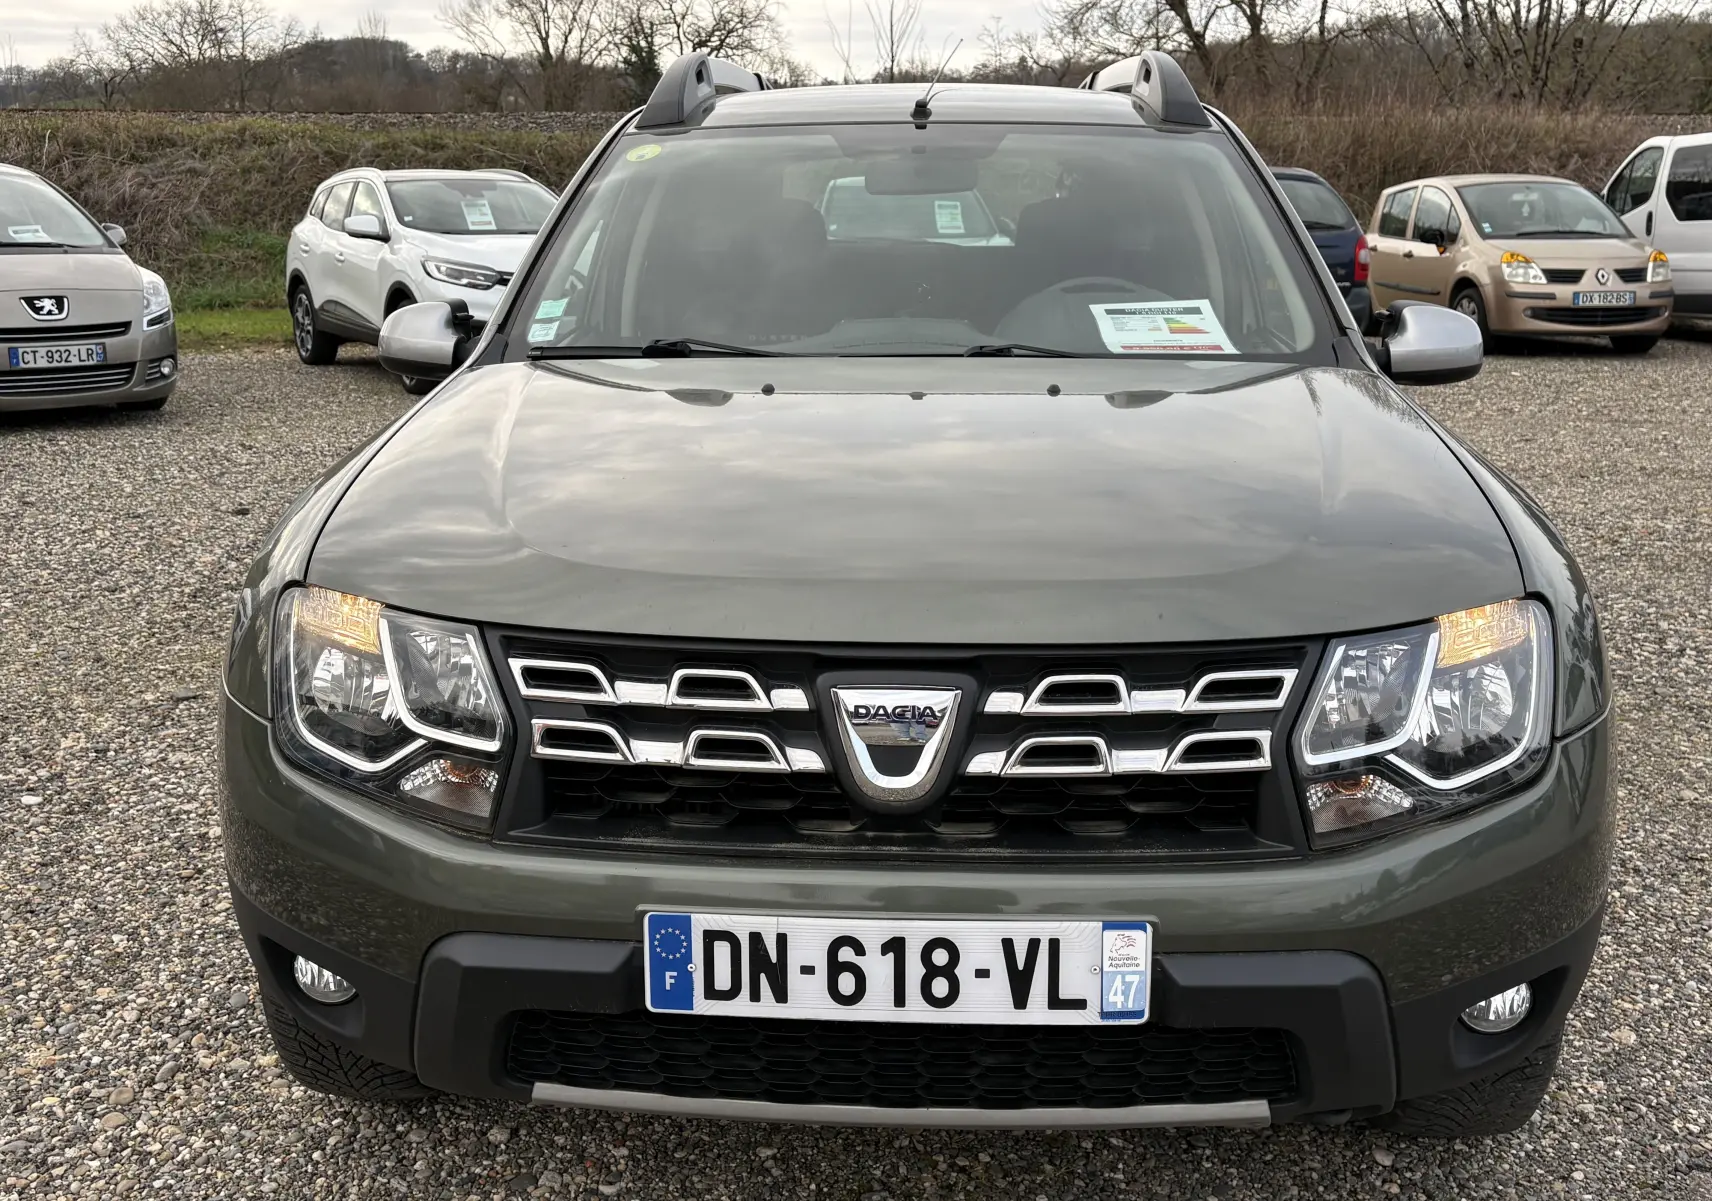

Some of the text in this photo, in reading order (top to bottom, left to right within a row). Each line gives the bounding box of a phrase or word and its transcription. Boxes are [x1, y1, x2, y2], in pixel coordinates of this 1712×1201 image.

[21, 348, 95, 365] CT-932-LR
[853, 704, 938, 721] DACIA
[702, 928, 1088, 1011] DN-618-VL
[664, 971, 678, 991] F
[1108, 974, 1140, 1009] 47
